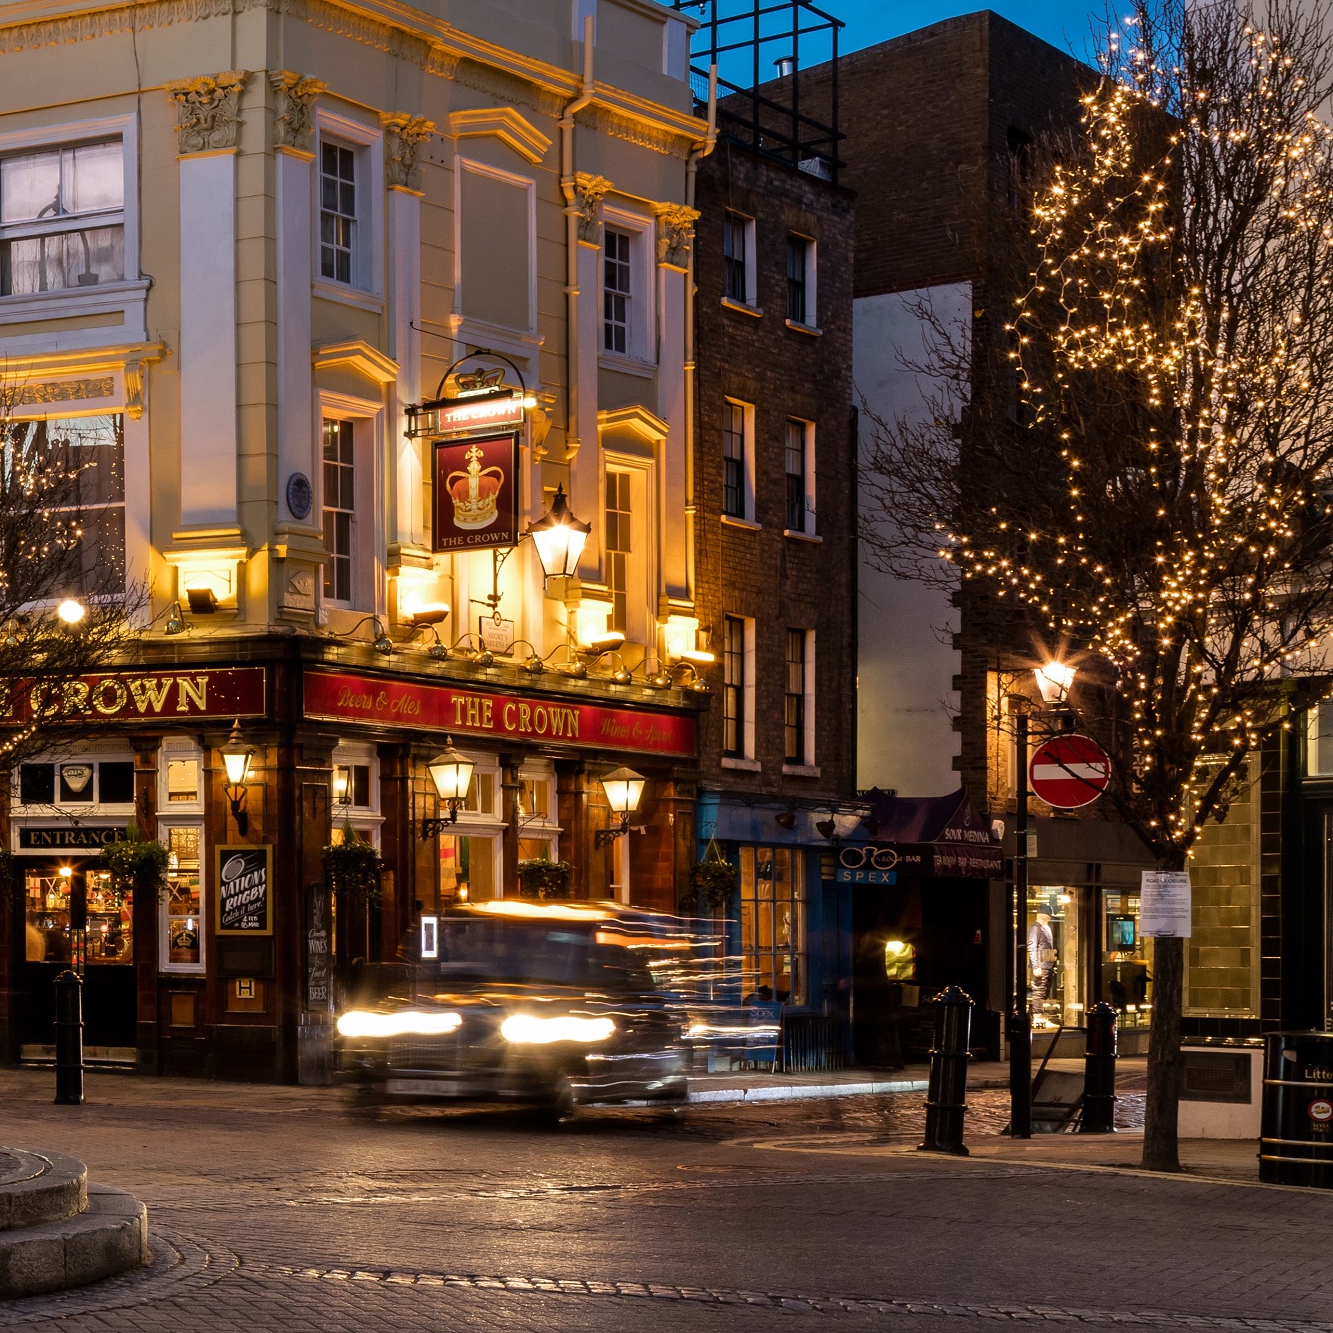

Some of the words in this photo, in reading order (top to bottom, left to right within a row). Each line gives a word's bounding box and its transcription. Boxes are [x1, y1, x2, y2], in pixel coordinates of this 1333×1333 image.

[445, 410, 469, 423] THE
[471, 402, 517, 419] CROWN
[442, 536, 464, 547] THE
[467, 531, 509, 544] CROWN
[31, 675, 209, 717] CROWN
[337, 685, 373, 712] Beers
[375, 691, 388, 711] &
[391, 694, 420, 716] Ales
[451, 695, 494, 729] THE
[503, 701, 580, 738] CROWN
[600, 716, 632, 740] Wines
[30, 828, 125, 846] ENTRANCE
[963, 830, 989, 843] MEDINA
[905, 855, 921, 863] BAR
[220, 867, 266, 899] NATIONS
[843, 871, 890, 883] SPEX
[225, 884, 267, 912] RUGBY
[308, 939, 328, 954] WINES
[238, 979, 252, 996] H
[309, 986, 327, 1000] BEER
